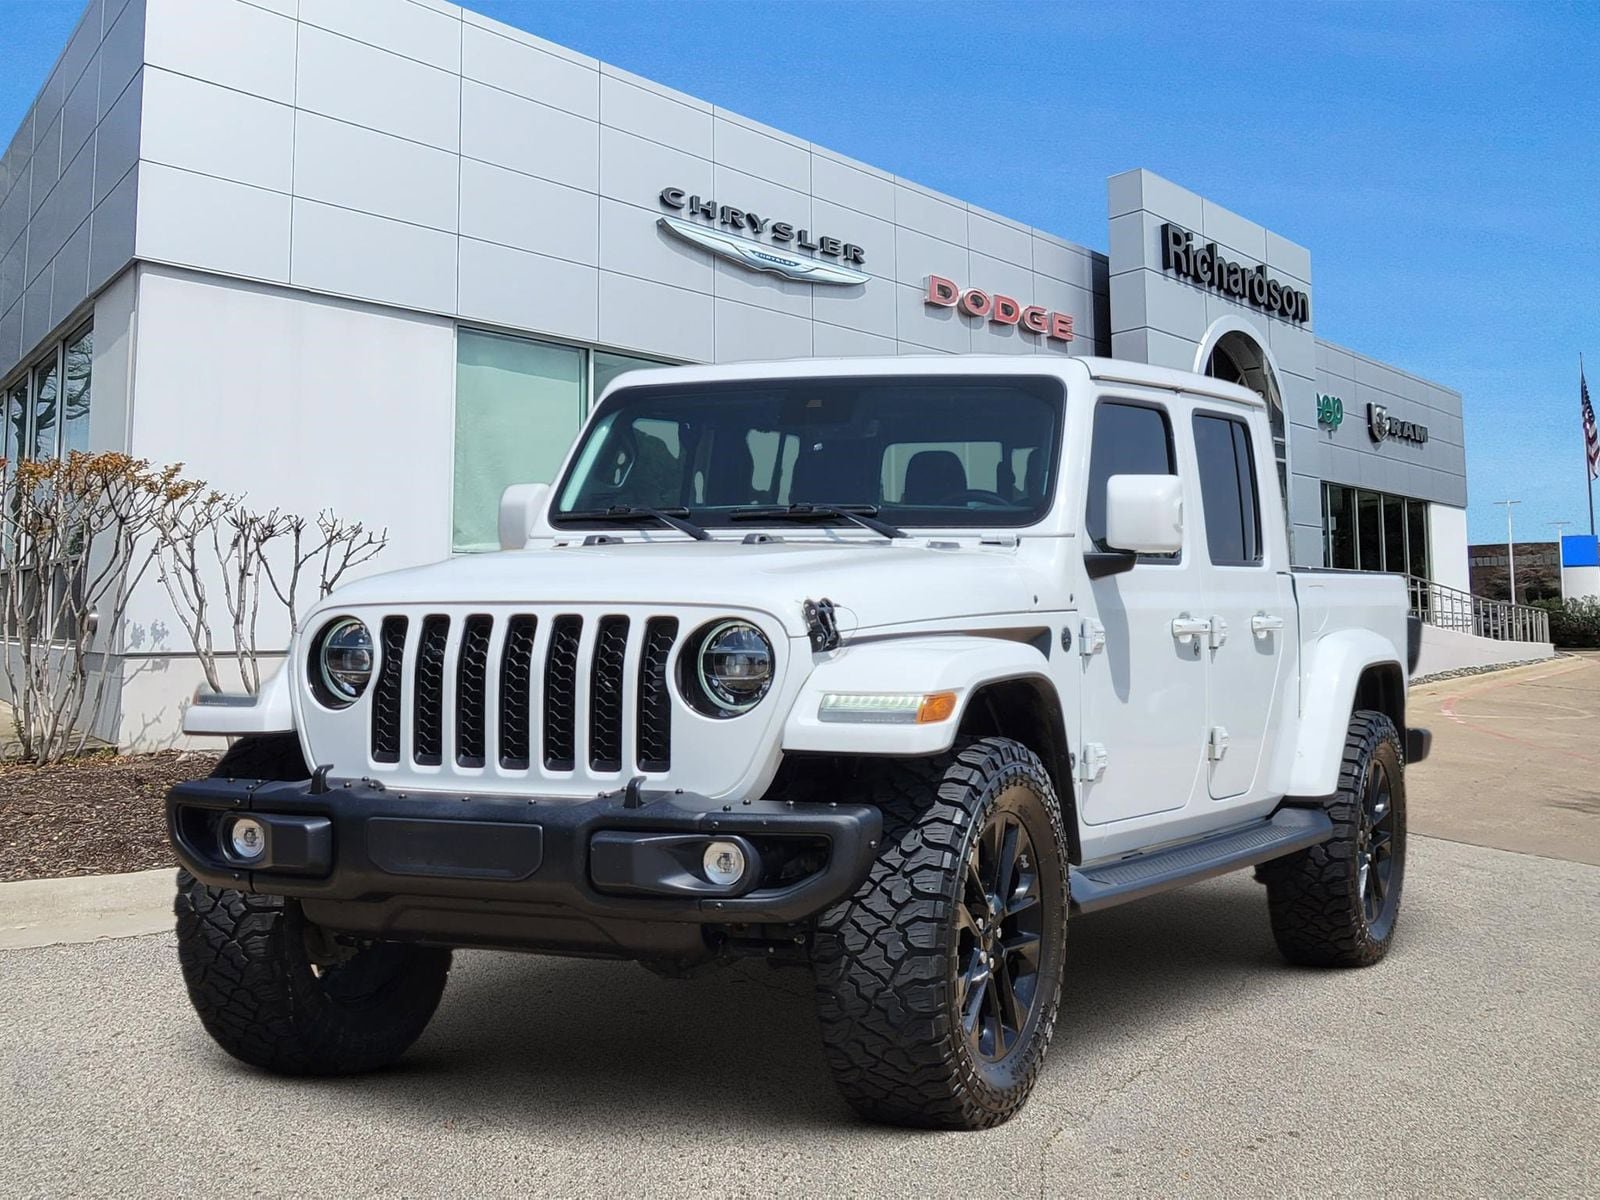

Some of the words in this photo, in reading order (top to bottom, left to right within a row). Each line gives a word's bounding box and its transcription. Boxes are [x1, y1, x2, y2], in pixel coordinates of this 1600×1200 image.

[659, 187, 866, 264] CHRYSLER
[924, 274, 1073, 342] DODGE
[1161, 223, 1309, 323] Richardson
[1388, 416, 1428, 443] RAM
